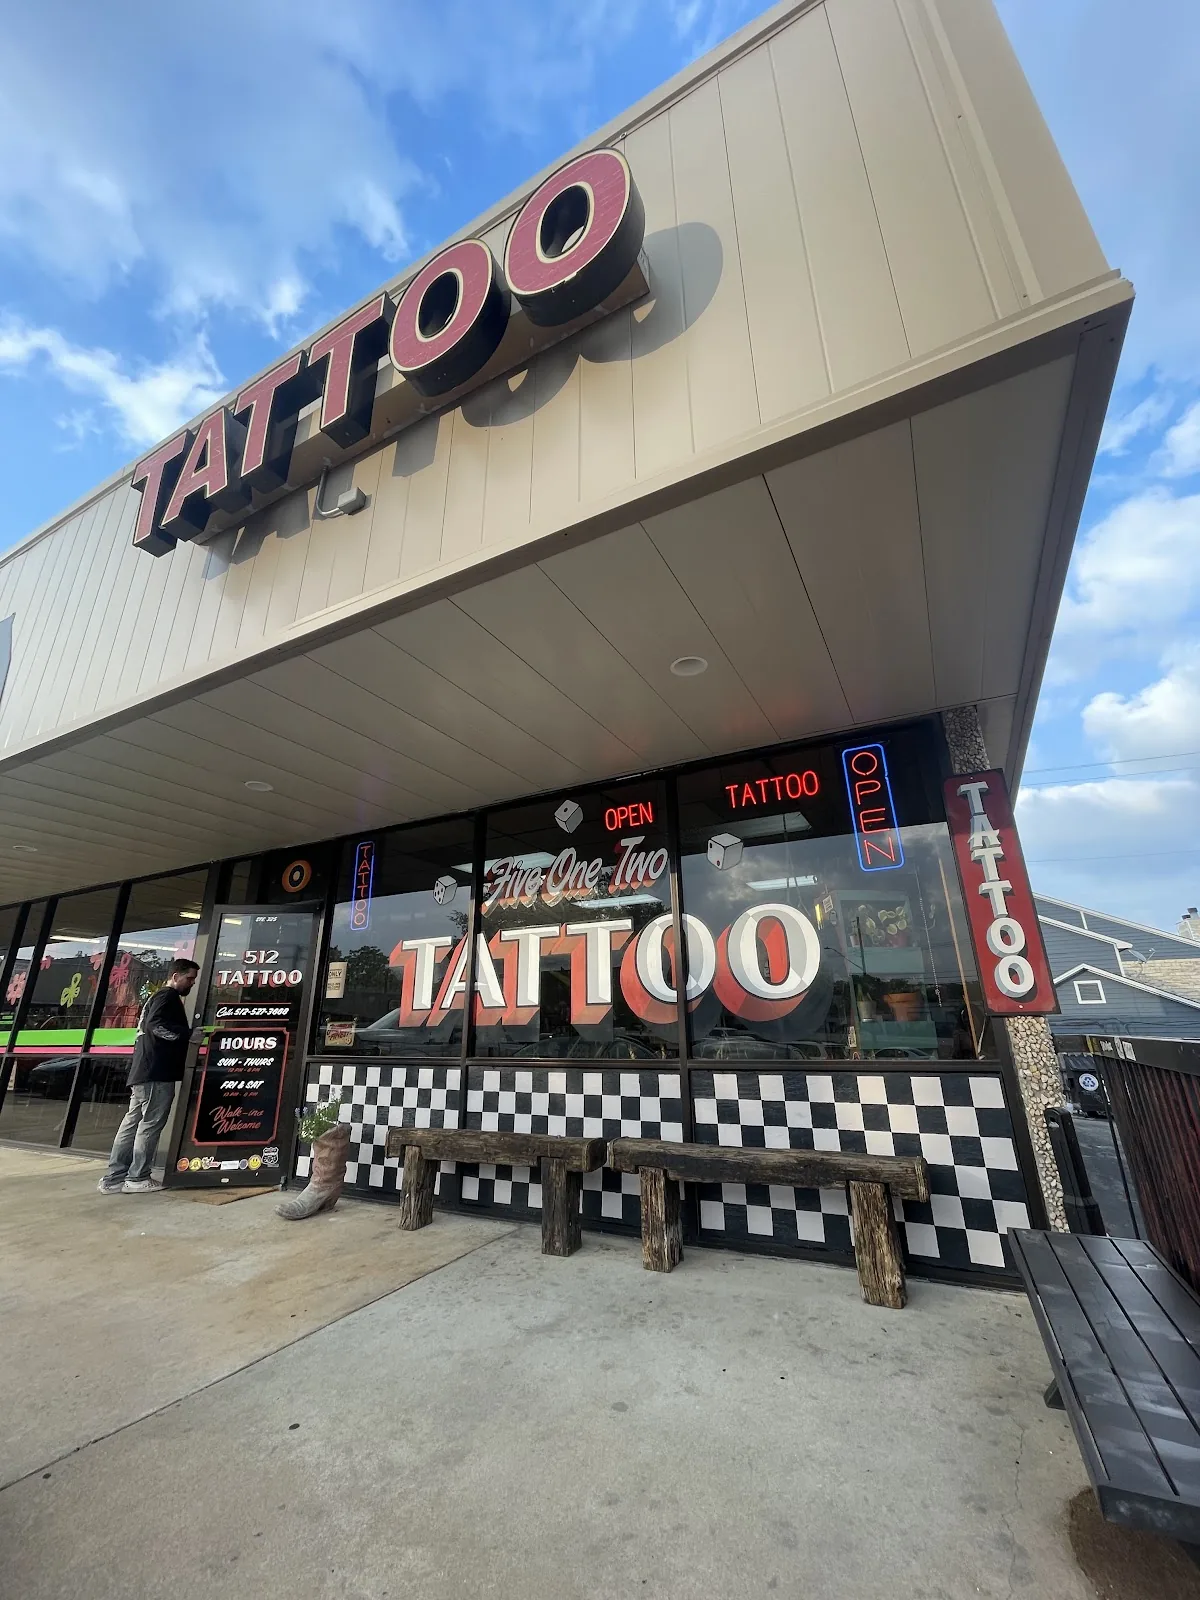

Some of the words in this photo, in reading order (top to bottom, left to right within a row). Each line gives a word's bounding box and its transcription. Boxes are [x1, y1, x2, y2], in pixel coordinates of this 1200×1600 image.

[131, 147, 645, 557] TATTOO
[725, 770, 820, 809] TATTOO
[604, 802, 654, 831] OPEN
[850, 751, 896, 866] OPEN
[354, 845, 372, 925] TATTOO
[482, 855, 542, 914] Five
[542, 847, 603, 905] One
[609, 836, 669, 892] Two
[957, 781, 1035, 998] TATTOO
[243, 950, 280, 964] 512
[390, 903, 821, 1026] TATTOO
[217, 969, 303, 988] TATTOO
[220, 1036, 278, 1050] HOURS
[217, 1057, 239, 1067] SUN
[243, 1057, 274, 1067] THURS
[220, 1080, 239, 1090] FRI
[237, 1080, 245, 1089] &
[245, 1080, 264, 1090] SAT
[212, 1118, 261, 1135] Welcome
